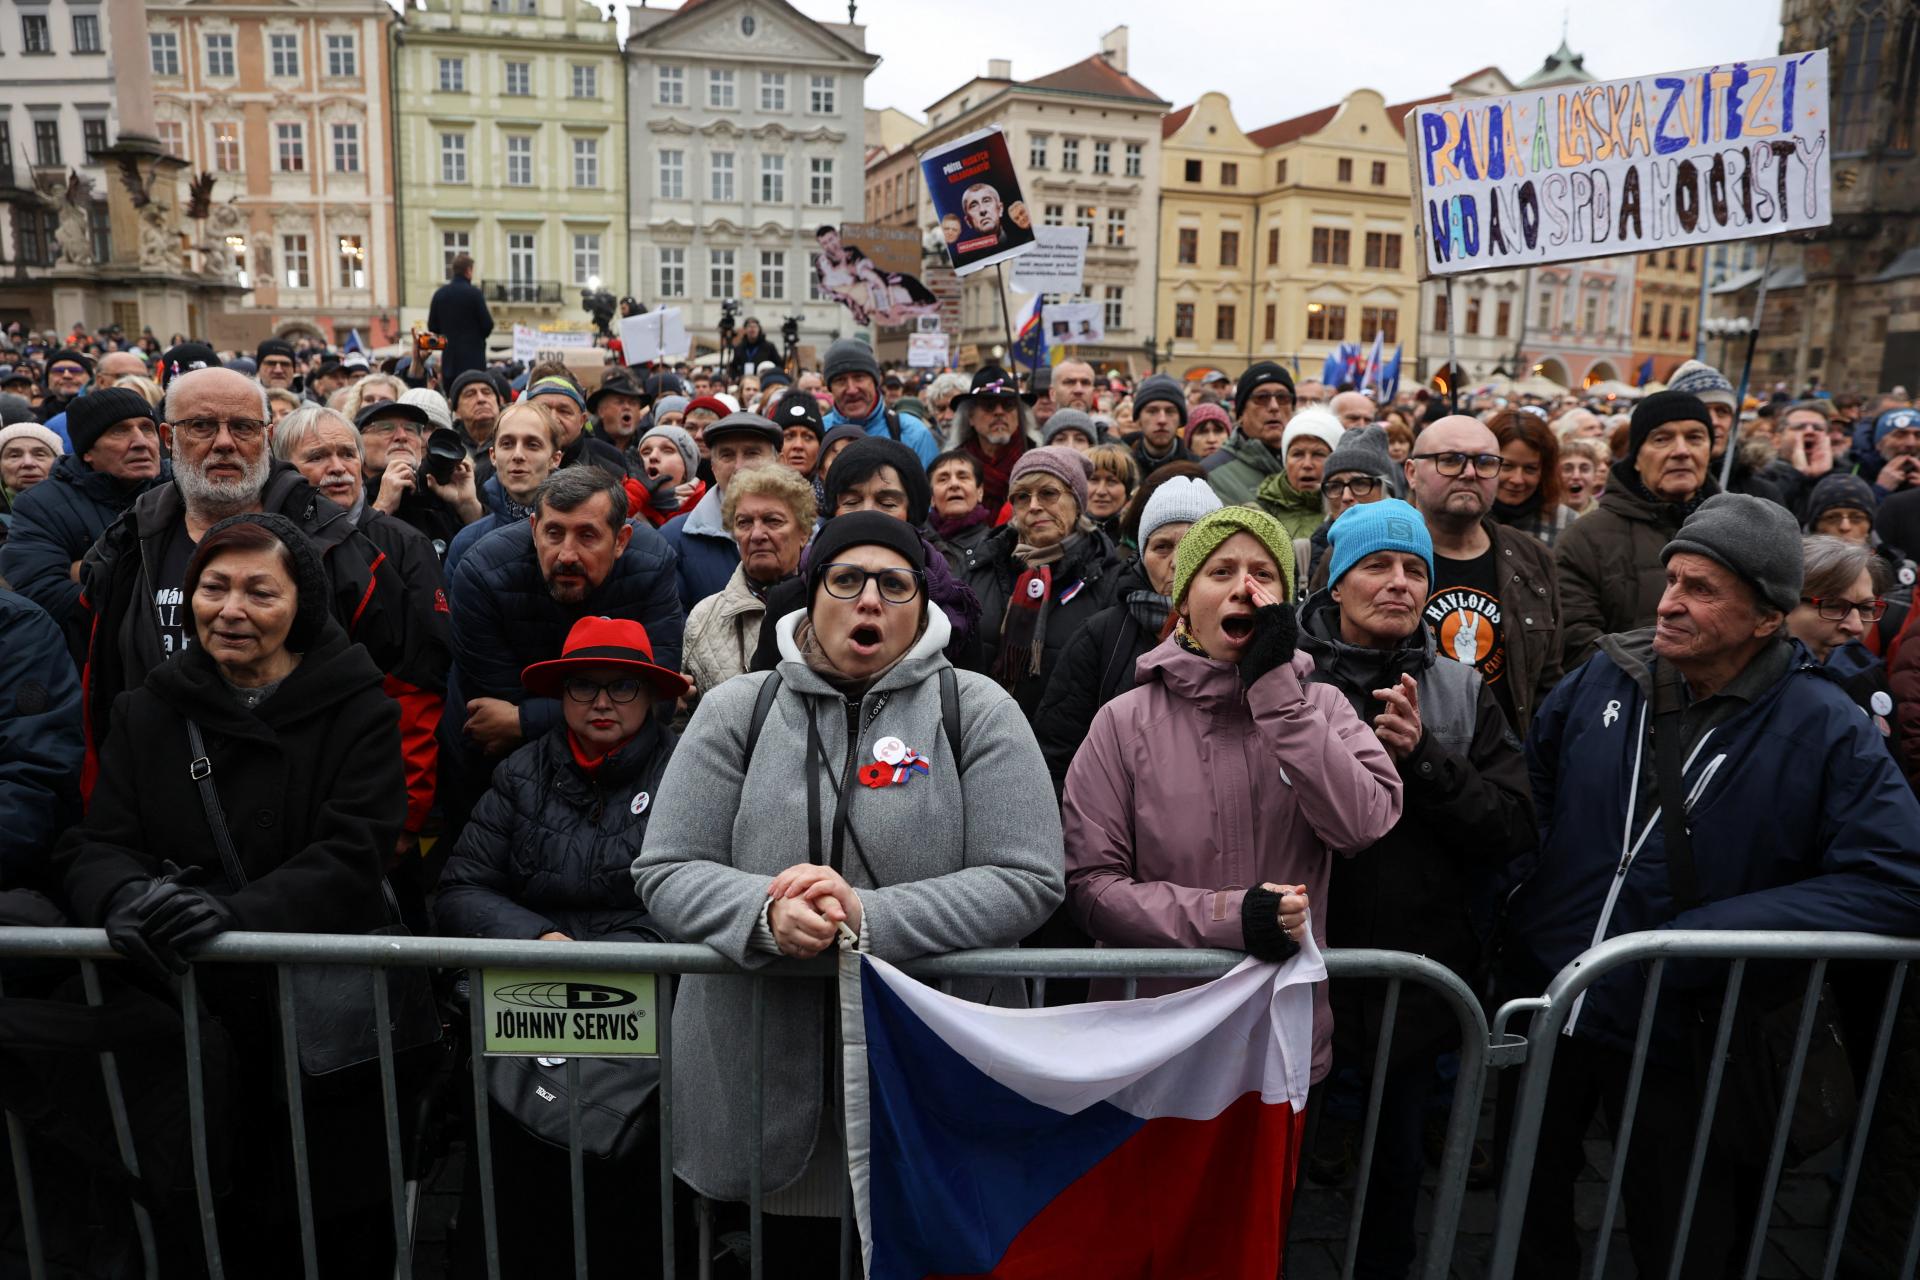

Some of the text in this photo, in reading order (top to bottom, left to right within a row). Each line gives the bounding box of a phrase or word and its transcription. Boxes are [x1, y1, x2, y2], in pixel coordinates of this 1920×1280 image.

[1422, 100, 1525, 187] PRAVDA
[1532, 97, 1552, 172] A
[1429, 194, 1479, 264] NAD
[1541, 168, 1610, 246] SPD
[1618, 164, 1643, 241] A
[495, 1010, 567, 1039] JOHNNY
